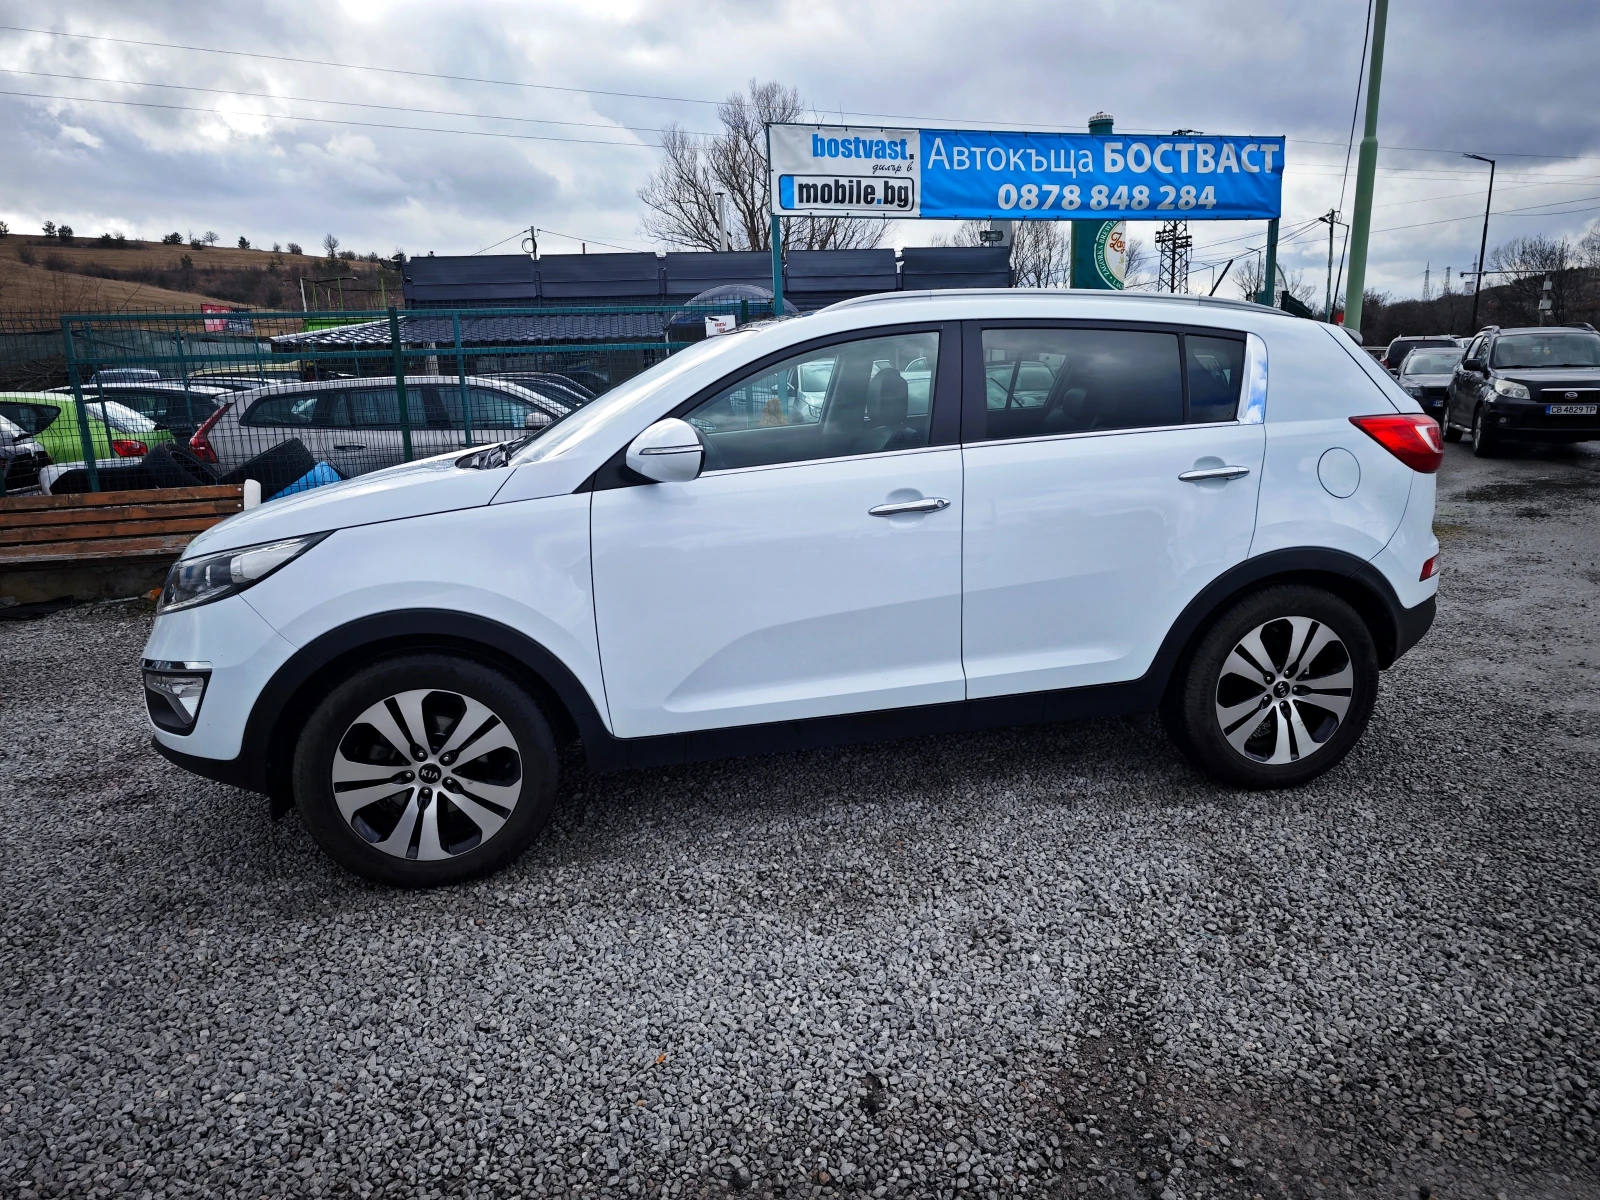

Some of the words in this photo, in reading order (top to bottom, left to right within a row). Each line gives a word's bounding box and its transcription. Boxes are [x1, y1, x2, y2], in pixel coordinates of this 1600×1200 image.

[811, 133, 915, 160] bostvast.
[927, 137, 1094, 179] Автокъща
[1104, 142, 1280, 174] БОСТВАСТ
[872, 162, 903, 175] дилър
[797, 179, 909, 208] mobile.bg
[997, 183, 1082, 211] 0878
[1089, 184, 1150, 211] 848
[1156, 184, 1217, 211] 284
[1551, 405, 1562, 414] CB
[1563, 405, 1584, 414] 4829
[1585, 405, 1596, 414] TP
[420, 769, 439, 779] KIA
